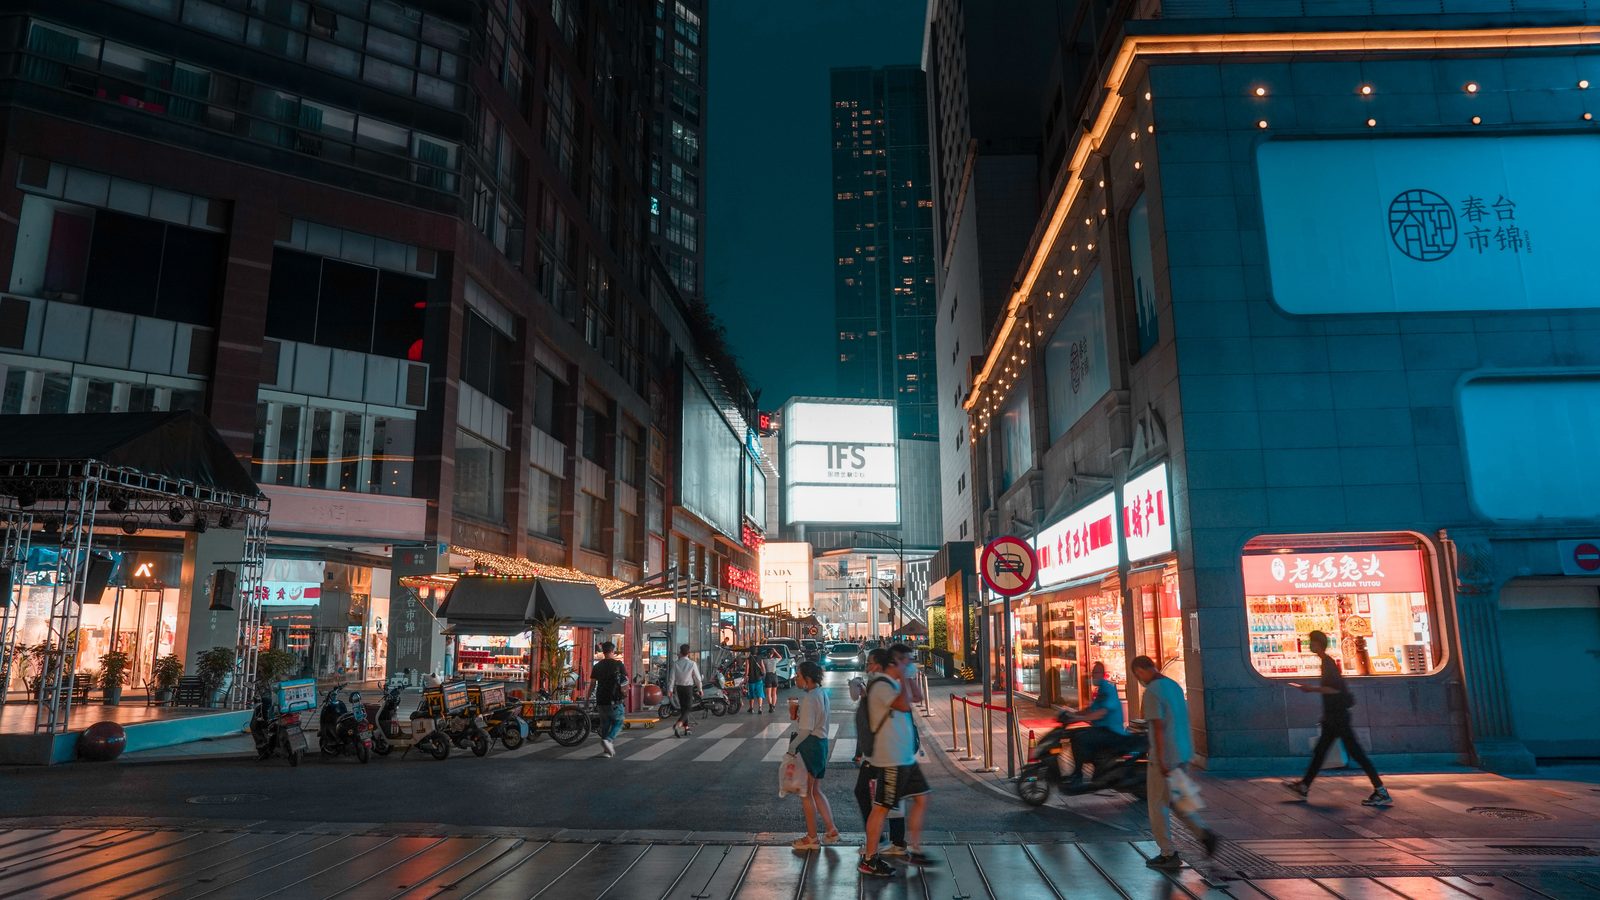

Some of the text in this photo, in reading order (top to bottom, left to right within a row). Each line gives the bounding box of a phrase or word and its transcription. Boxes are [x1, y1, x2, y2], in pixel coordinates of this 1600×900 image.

[827, 443, 866, 470] IFS
[1288, 553, 1385, 583] 老妈兔头
